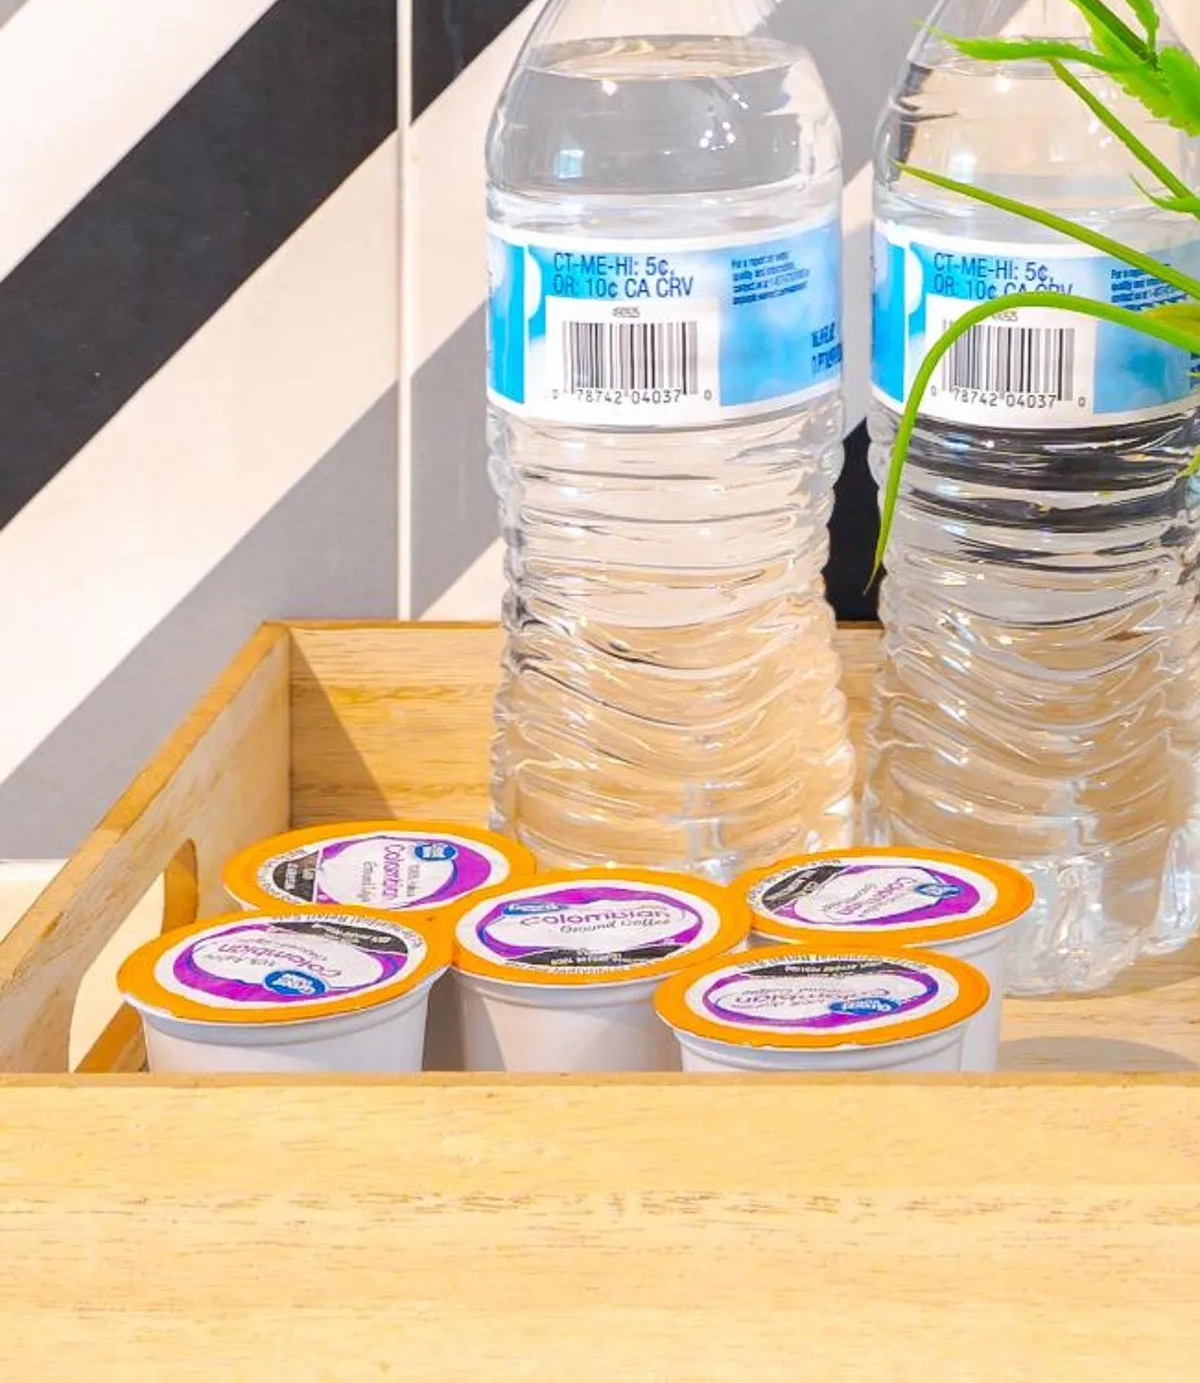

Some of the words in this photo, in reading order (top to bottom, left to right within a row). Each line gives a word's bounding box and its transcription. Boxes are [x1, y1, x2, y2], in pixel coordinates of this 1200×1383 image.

[553, 252, 639, 276] CT-ME-HI:
[934, 252, 1019, 280] CT-ME-HI:
[624, 278, 651, 298] CA
[656, 276, 694, 298] CRV
[576, 389, 622, 405] 78742
[631, 390, 681, 405] 04037
[703, 389, 712, 401] 0
[954, 386, 998, 407] 78742
[1006, 394, 1057, 408] 04037
